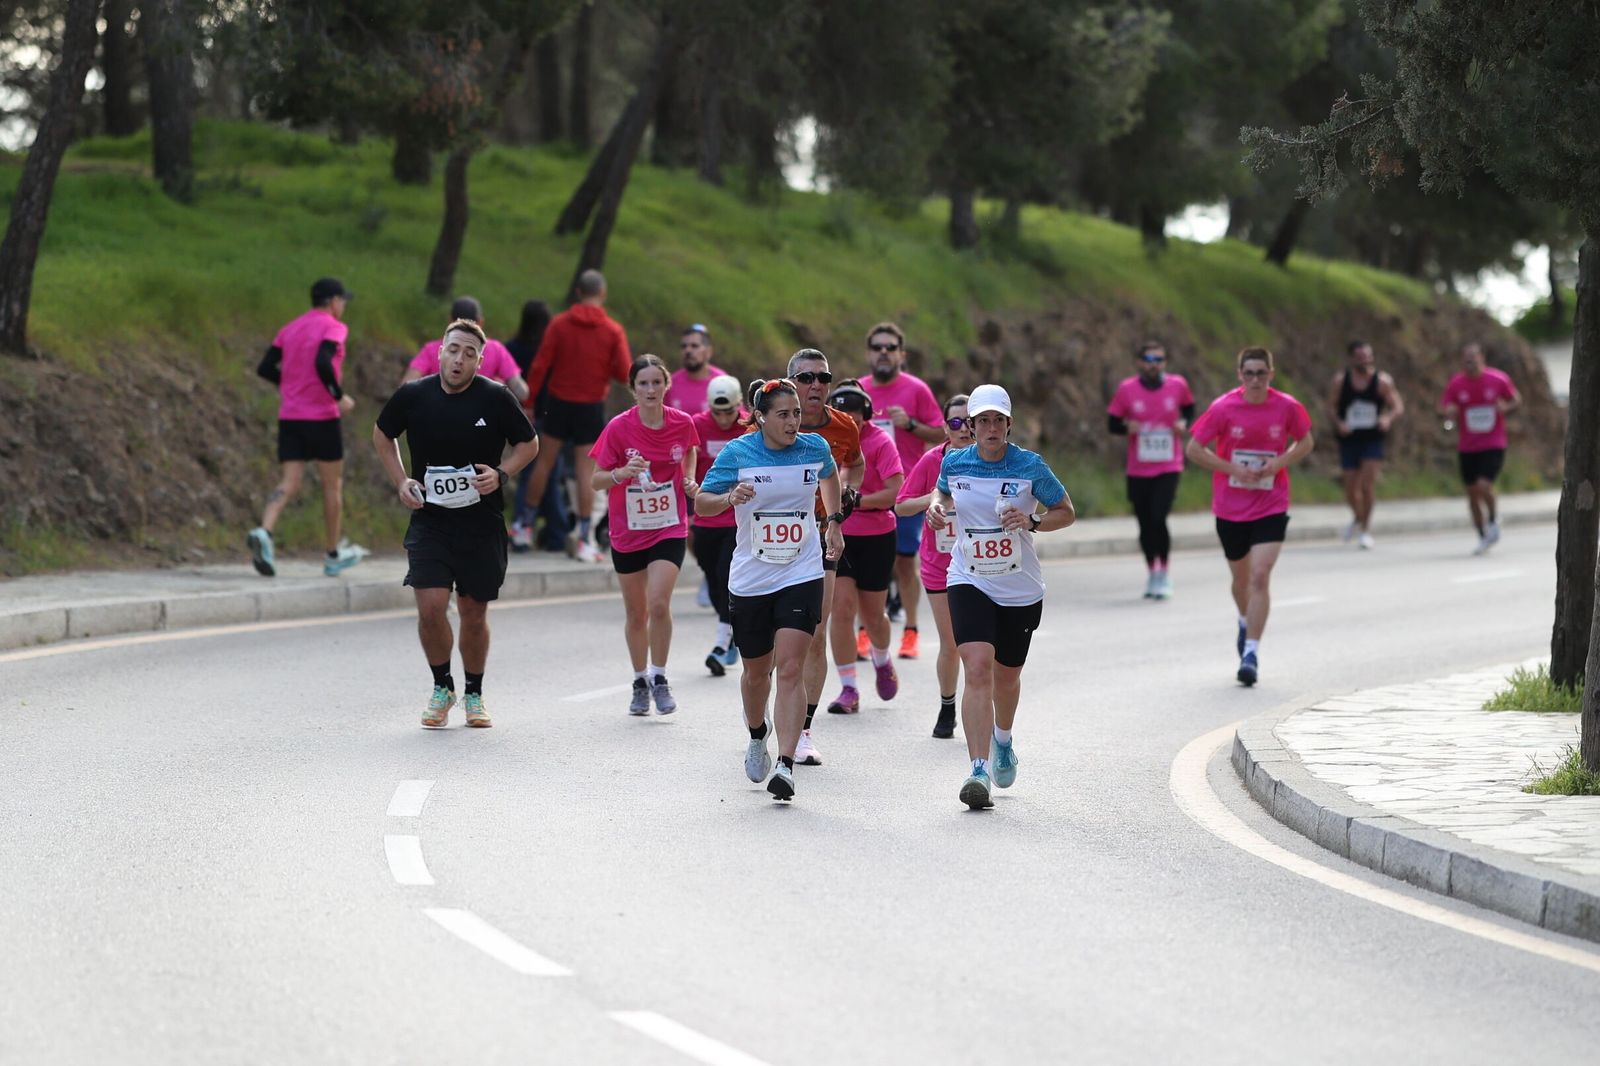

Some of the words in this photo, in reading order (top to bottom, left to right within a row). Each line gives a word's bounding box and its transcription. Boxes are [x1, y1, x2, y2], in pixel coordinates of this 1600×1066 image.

[434, 477, 470, 495] 603
[636, 495, 670, 514] 138
[762, 523, 803, 543] 190
[972, 538, 1013, 559] 188
